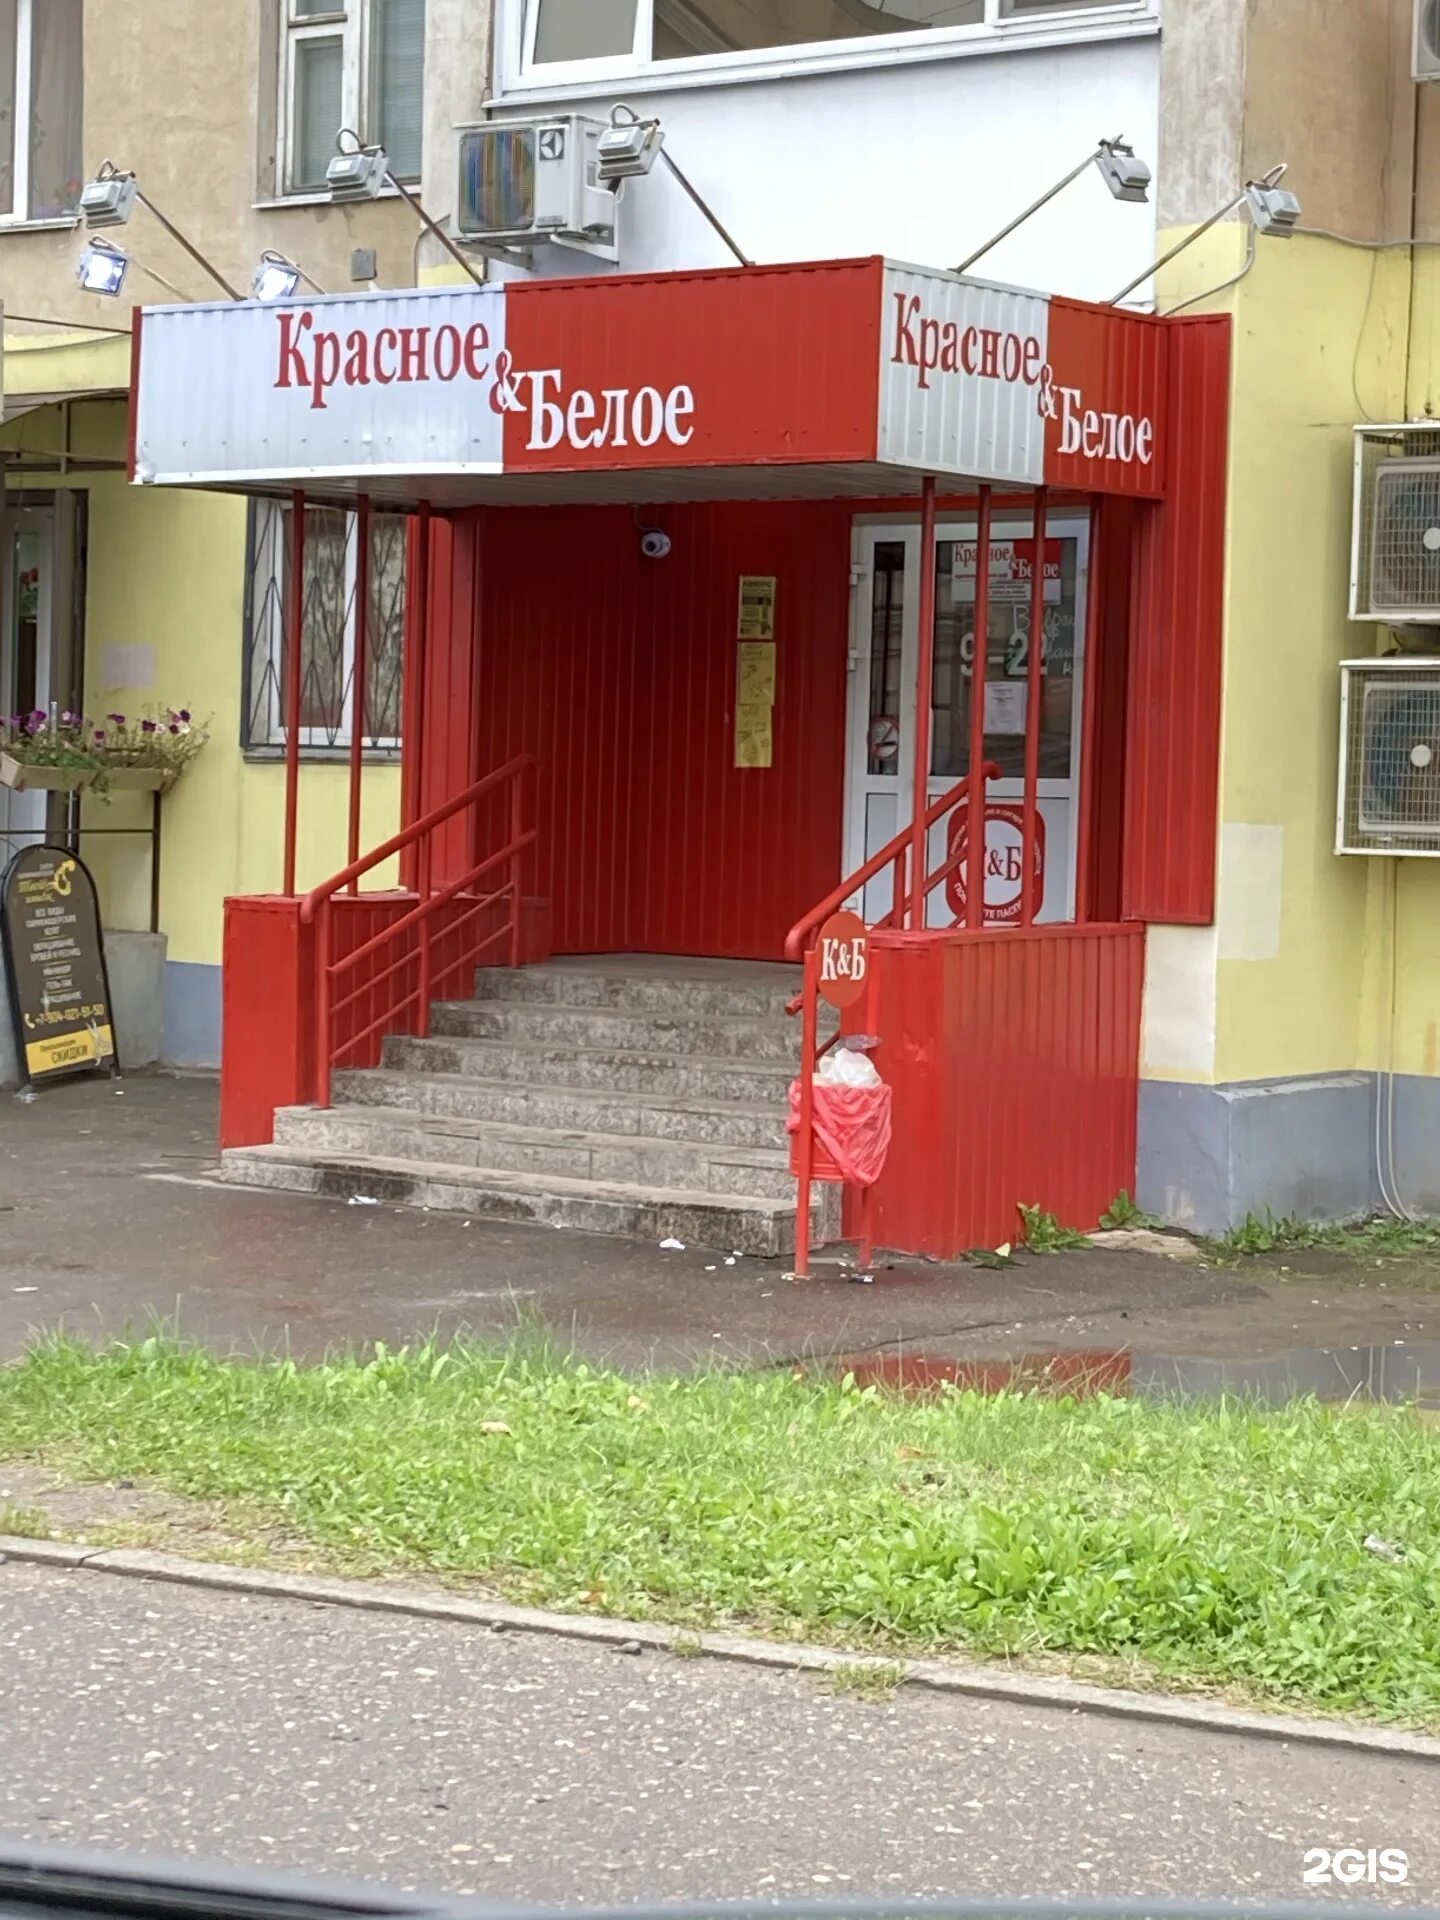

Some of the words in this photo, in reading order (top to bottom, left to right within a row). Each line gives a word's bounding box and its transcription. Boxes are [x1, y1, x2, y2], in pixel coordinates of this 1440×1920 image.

[273, 311, 490, 410] Красное
[525, 368, 695, 451] Белое
[891, 292, 1041, 389] Красное
[1057, 386, 1153, 465] Белое
[1016, 558, 1060, 578] Беое
[983, 846, 1022, 881] &Б
[820, 937, 866, 981] К&Б
